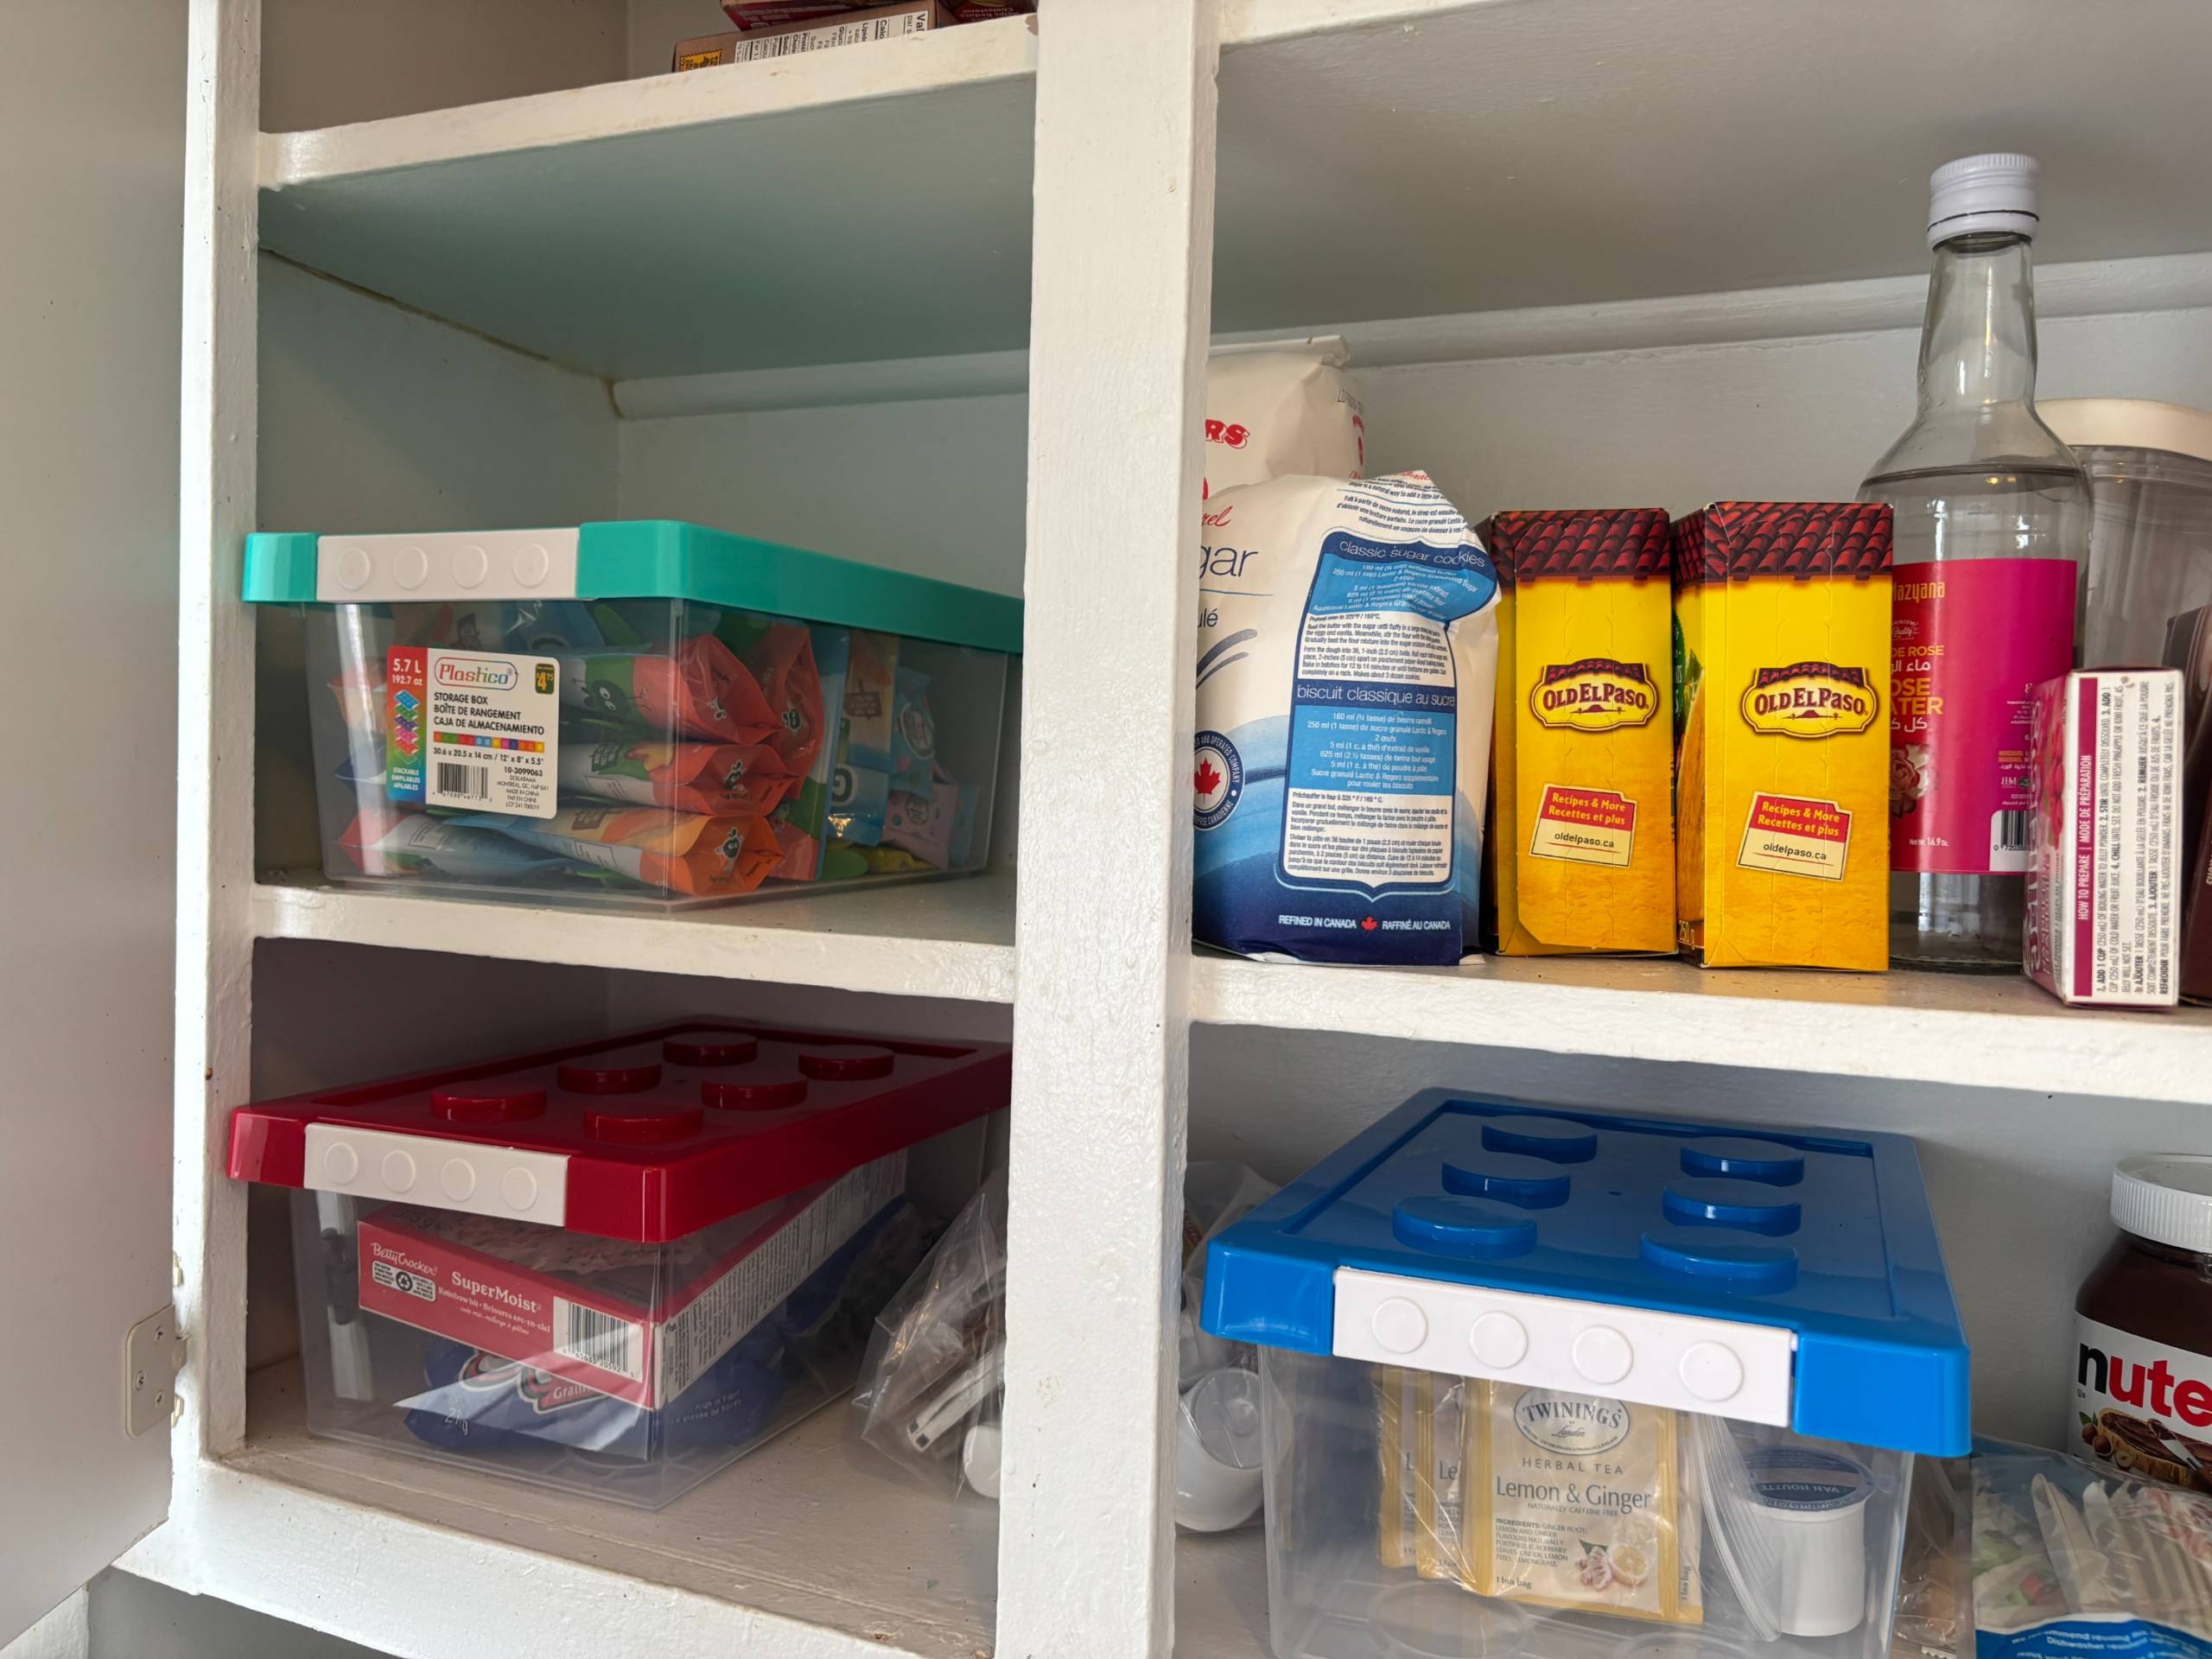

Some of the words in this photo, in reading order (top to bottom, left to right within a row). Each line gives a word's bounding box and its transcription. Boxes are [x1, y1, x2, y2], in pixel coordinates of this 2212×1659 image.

[1339, 541, 1386, 558] classic
[1391, 548, 1428, 562] sugar
[1434, 550, 1484, 568] cookies
[1908, 645, 1944, 656] ROSE
[393, 658, 411, 671] 5.7
[415, 660, 421, 673] L
[1905, 658, 1931, 671] ماء
[391, 675, 412, 684] 192.7
[439, 663, 509, 684] Plastico
[434, 691, 468, 703] STORAGE
[472, 695, 488, 705] BOX
[1297, 684, 1343, 700] biscuit
[1347, 687, 1412, 707] classique
[1415, 694, 1428, 704] au
[1432, 693, 1455, 707] sucre
[2101, 692, 2110, 707] ADD
[434, 703, 456, 715] BOÎTE
[458, 706, 468, 715] DE
[471, 708, 521, 720] RANGEMENT
[434, 716, 454, 727] CAJA
[456, 717, 467, 728] DE
[468, 719, 544, 735] ALMACENAMIENTO
[2101, 717, 2110, 747] DISSOLVED.
[474, 750, 482, 759] 14
[393, 766, 419, 776] STACKABLE
[504, 766, 543, 777] 10-3099063
[2100, 749, 2109, 781] COMPLETELY
[391, 774, 421, 784] EMPILABLES
[2077, 755, 2091, 805] PRÉPARATION
[2100, 782, 2108, 797] UNTIL
[1552, 792, 1589, 808] Recipes
[1592, 798, 1599, 808] &
[1601, 801, 1625, 812] More
[2099, 798, 2108, 813] STIR
[1548, 804, 1591, 821] Recettes
[1593, 811, 1604, 822] et
[1605, 814, 1625, 825] plus
[1762, 801, 1801, 817] Recipes
[1803, 808, 1811, 817] &
[1814, 810, 1840, 823] More
[2079, 808, 2090, 817] DE
[1758, 814, 1802, 830] Recettes
[1805, 821, 1815, 832] et
[1817, 823, 1840, 836] plus
[2078, 820, 2090, 842] MODE
[1554, 832, 1614, 848] oldelpaso.ca
[1927, 837, 1941, 846] 16.9
[2098, 824, 2108, 847] POWDER.
[1763, 842, 1827, 860] oldelpaso.ca
[2098, 849, 2107, 862] JELLY
[2111, 842, 2120, 861] CHILL
[2078, 855, 2089, 887] PREPARE
[2098, 871, 2107, 888] WATER
[2078, 888, 2088, 899] TO
[2148, 871, 2158, 900] AJOUTER
[2097, 890, 2107, 912] BOILING
[2078, 901, 2089, 920] HOW
[1279, 915, 1313, 926] REFINED
[1314, 918, 1323, 927] IN
[1324, 918, 1357, 929] CANADA
[1382, 918, 1412, 931] RAFFINÉ
[1413, 921, 1422, 930] AU
[1423, 920, 1451, 930] CANADA
[2097, 933, 2107, 945] (250
[2097, 948, 2106, 961] CUP
[2096, 969, 2106, 983] ADD
[2133, 956, 2143, 985] AJOUTER
[2159, 959, 2169, 995] REFROIDIR
[1522, 1402, 1622, 1429] TWININGS
[1440, 1460, 1458, 1480] Le
[1522, 1458, 1585, 1473] HERBAL
[1594, 1463, 1624, 1475] TEA
[1497, 1476, 1560, 1502] Lemon
[1567, 1483, 1580, 1503] &
[1586, 1484, 1651, 1515] Ginger
[1528, 1503, 1567, 1512] NATURALLY
[1496, 1518, 1541, 1529] INGREDIENTS:
[1502, 1577, 1515, 1586] tea
[1516, 1576, 1532, 1590] bag
